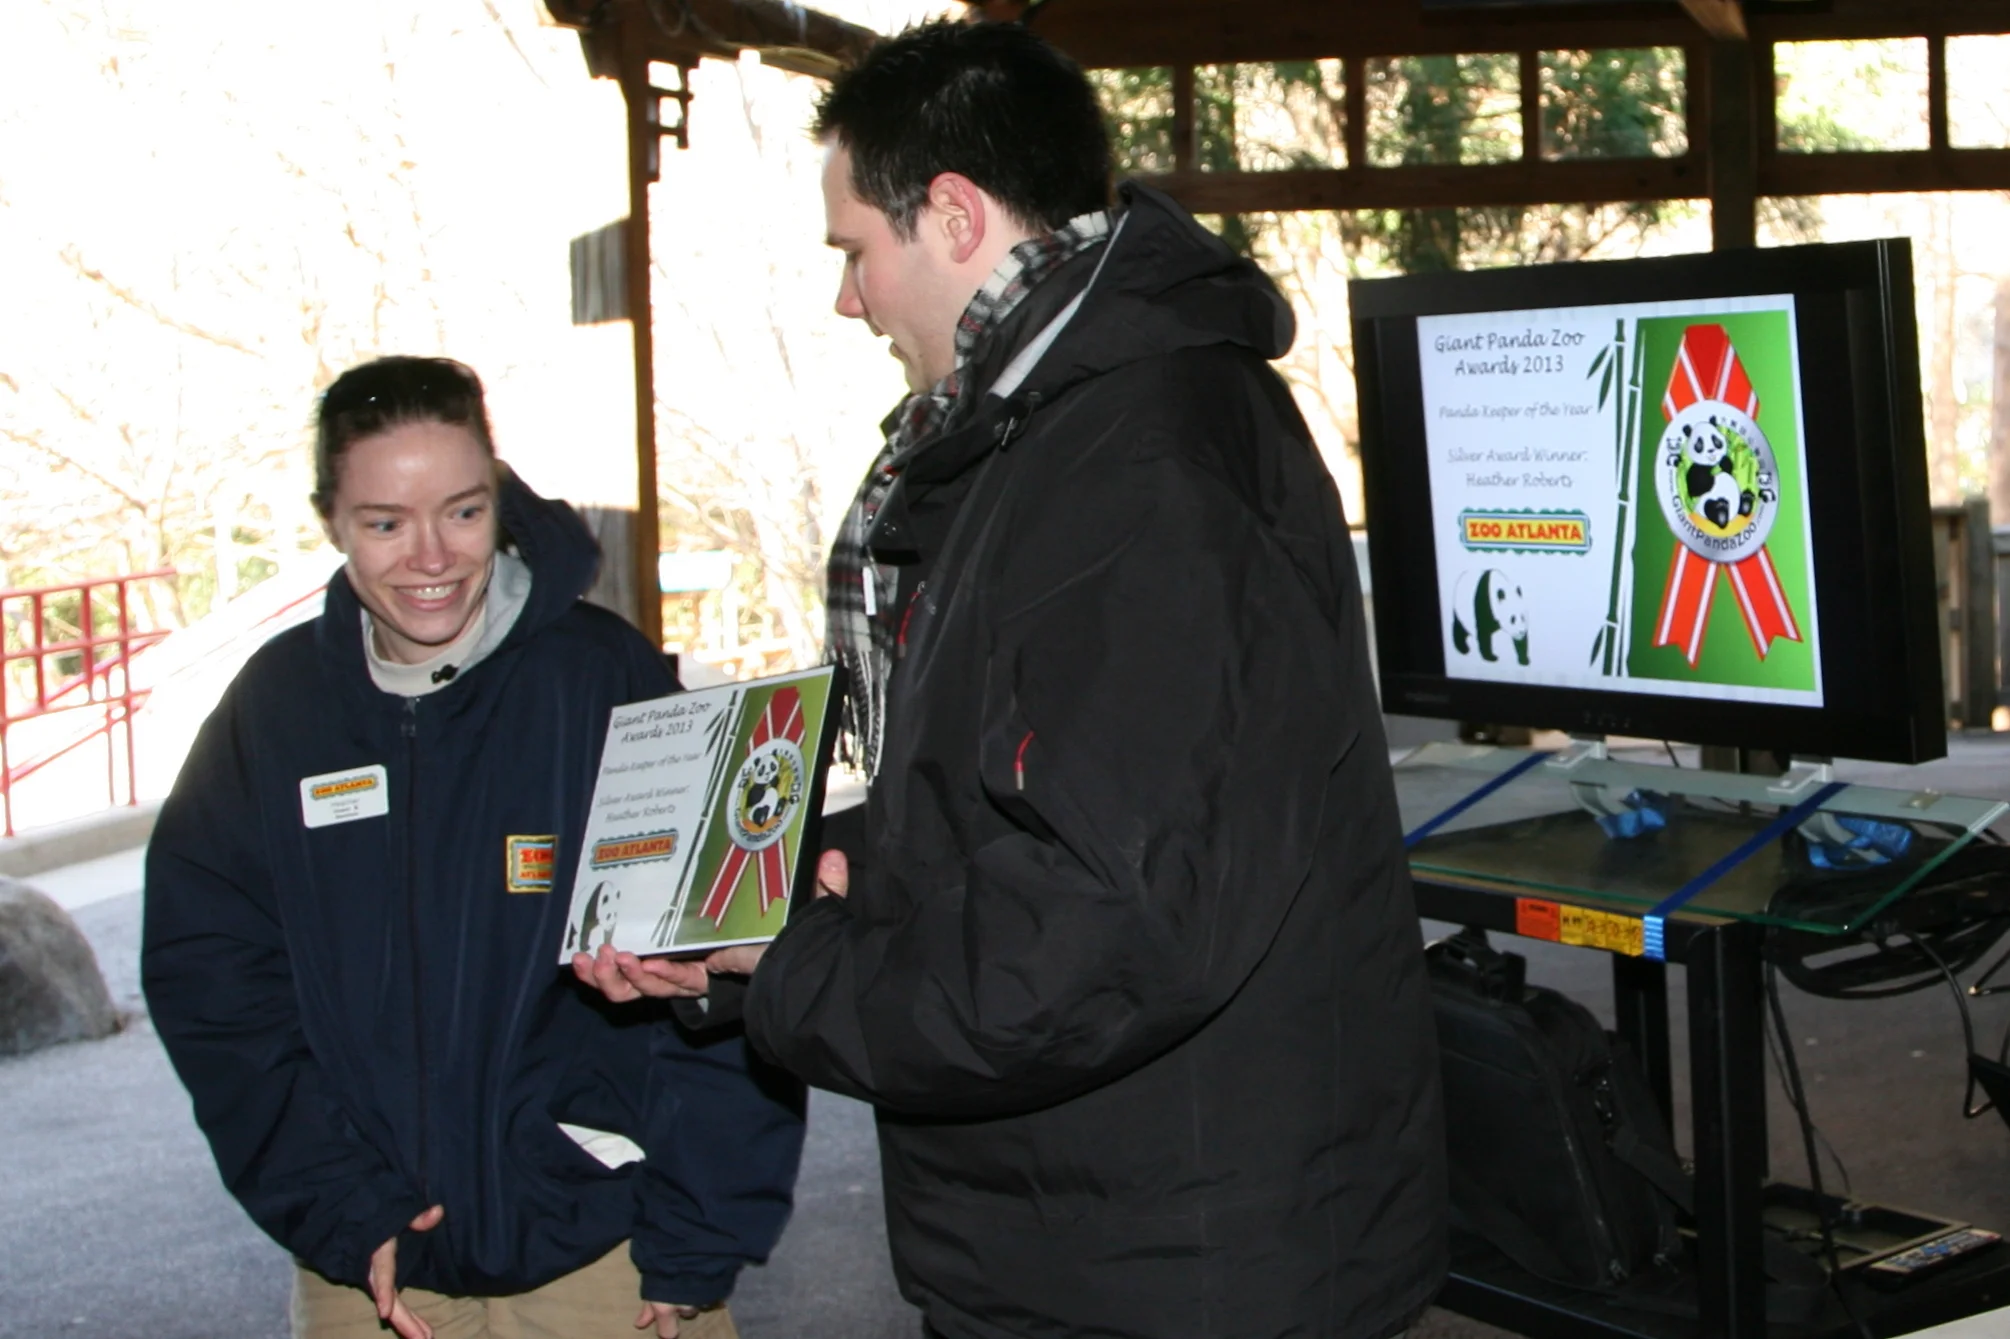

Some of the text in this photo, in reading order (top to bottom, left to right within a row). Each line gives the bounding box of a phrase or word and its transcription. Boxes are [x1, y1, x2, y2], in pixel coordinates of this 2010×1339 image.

[1434, 329, 1585, 353] Giant Panda Zoo
[1455, 354, 1564, 376] Awards 2013
[1438, 402, 1593, 421] Panda Keeper of the Year
[1447, 447, 1485, 463] Silver
[1486, 447, 1532, 462] Award
[1465, 471, 1573, 488] Heather Roberts
[1469, 522, 1582, 541] ZOO ATLANTA
[613, 701, 712, 729] Giant Panda Zoo
[621, 719, 694, 744] Awards 2013
[596, 838, 672, 861] ZOO ATLANTA
